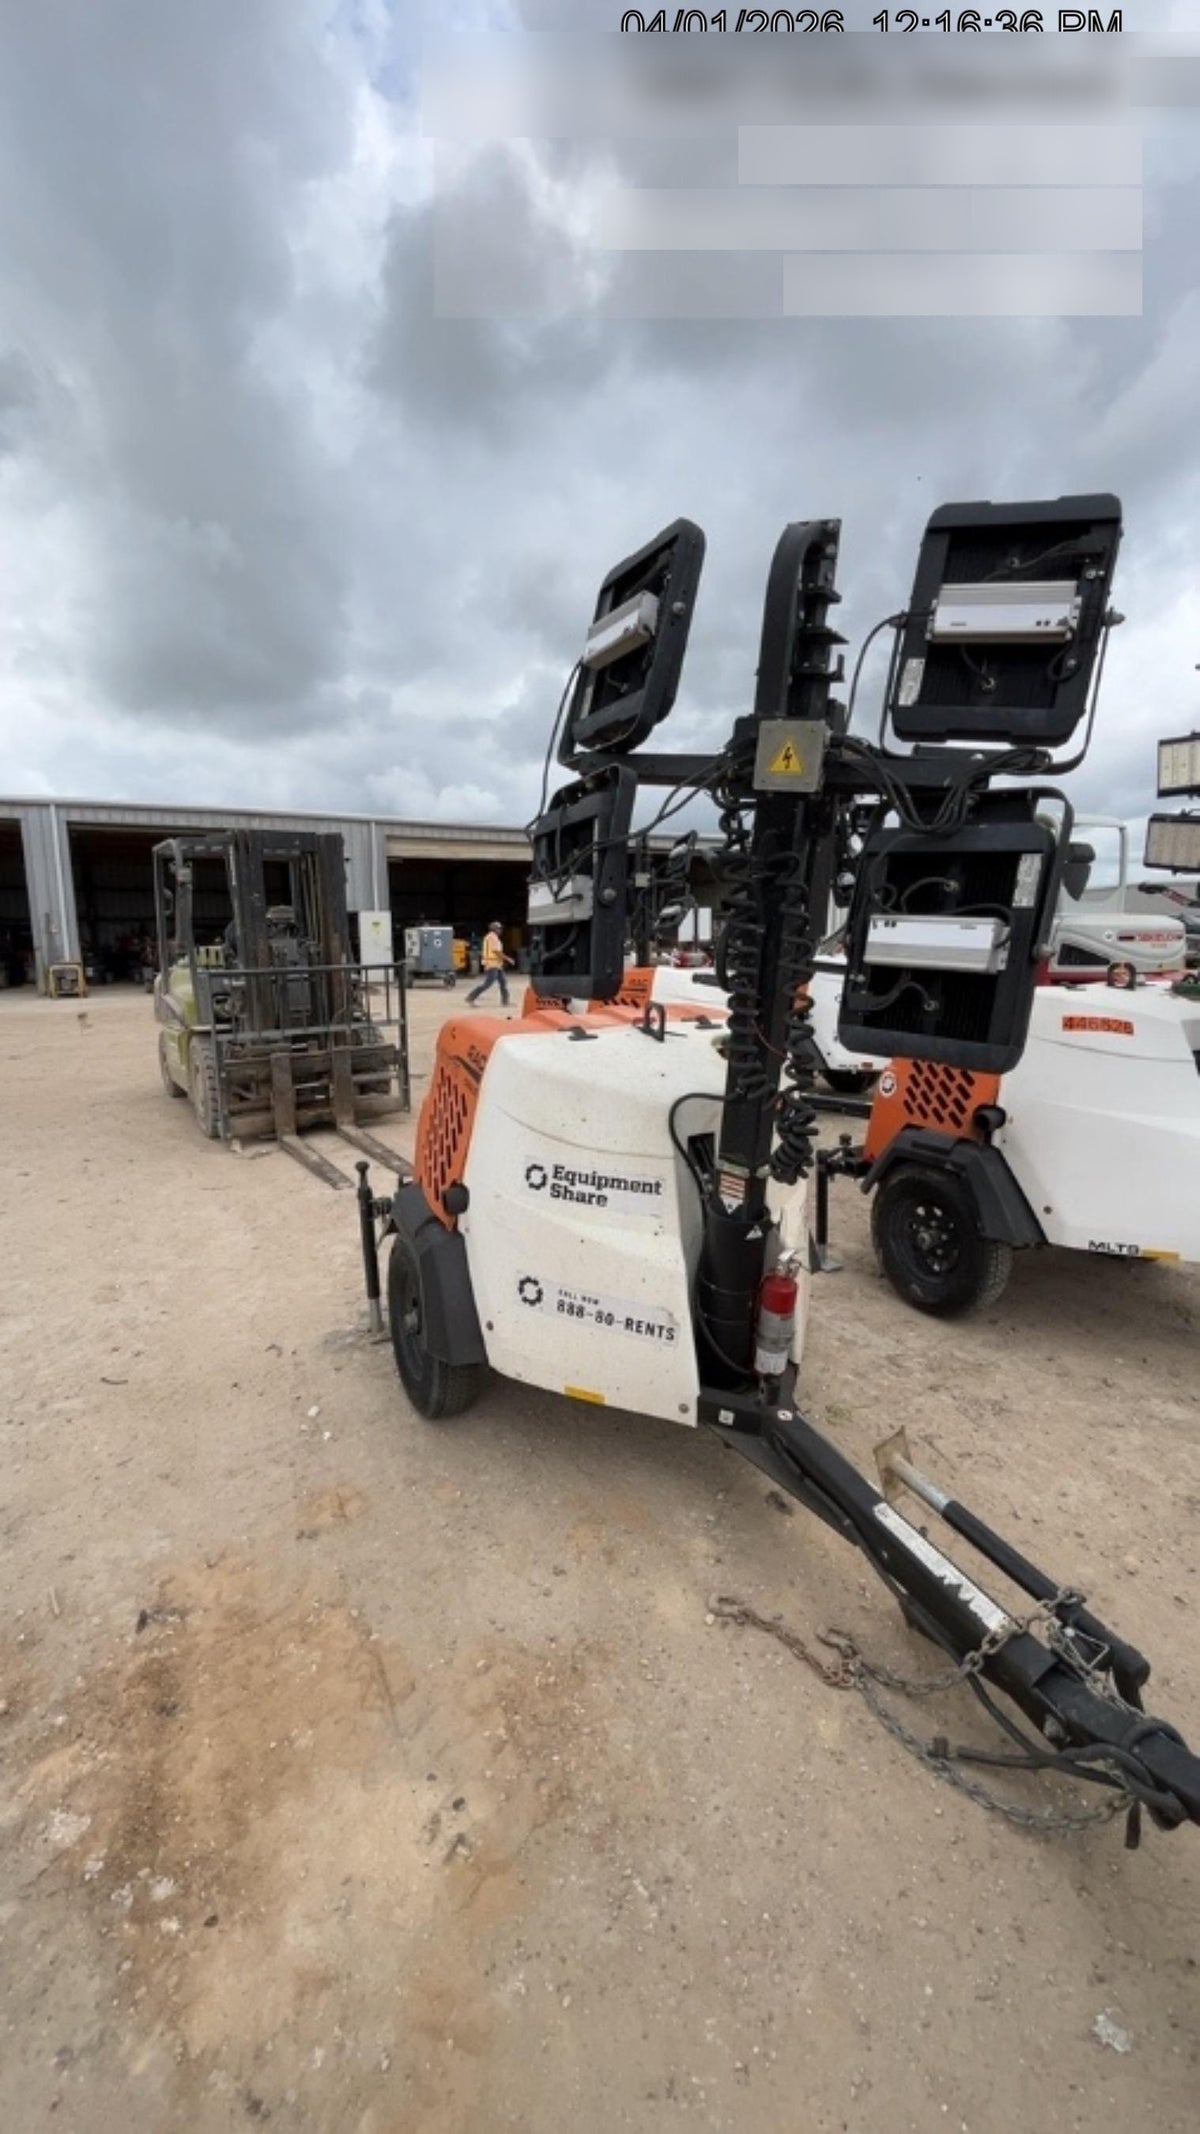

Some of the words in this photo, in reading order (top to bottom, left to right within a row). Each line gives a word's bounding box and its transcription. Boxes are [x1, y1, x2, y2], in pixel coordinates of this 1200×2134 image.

[550, 1182, 608, 1207] Share
[552, 1164, 662, 1195] Equipment
[557, 1299, 675, 1341] 888-80-RENTS
